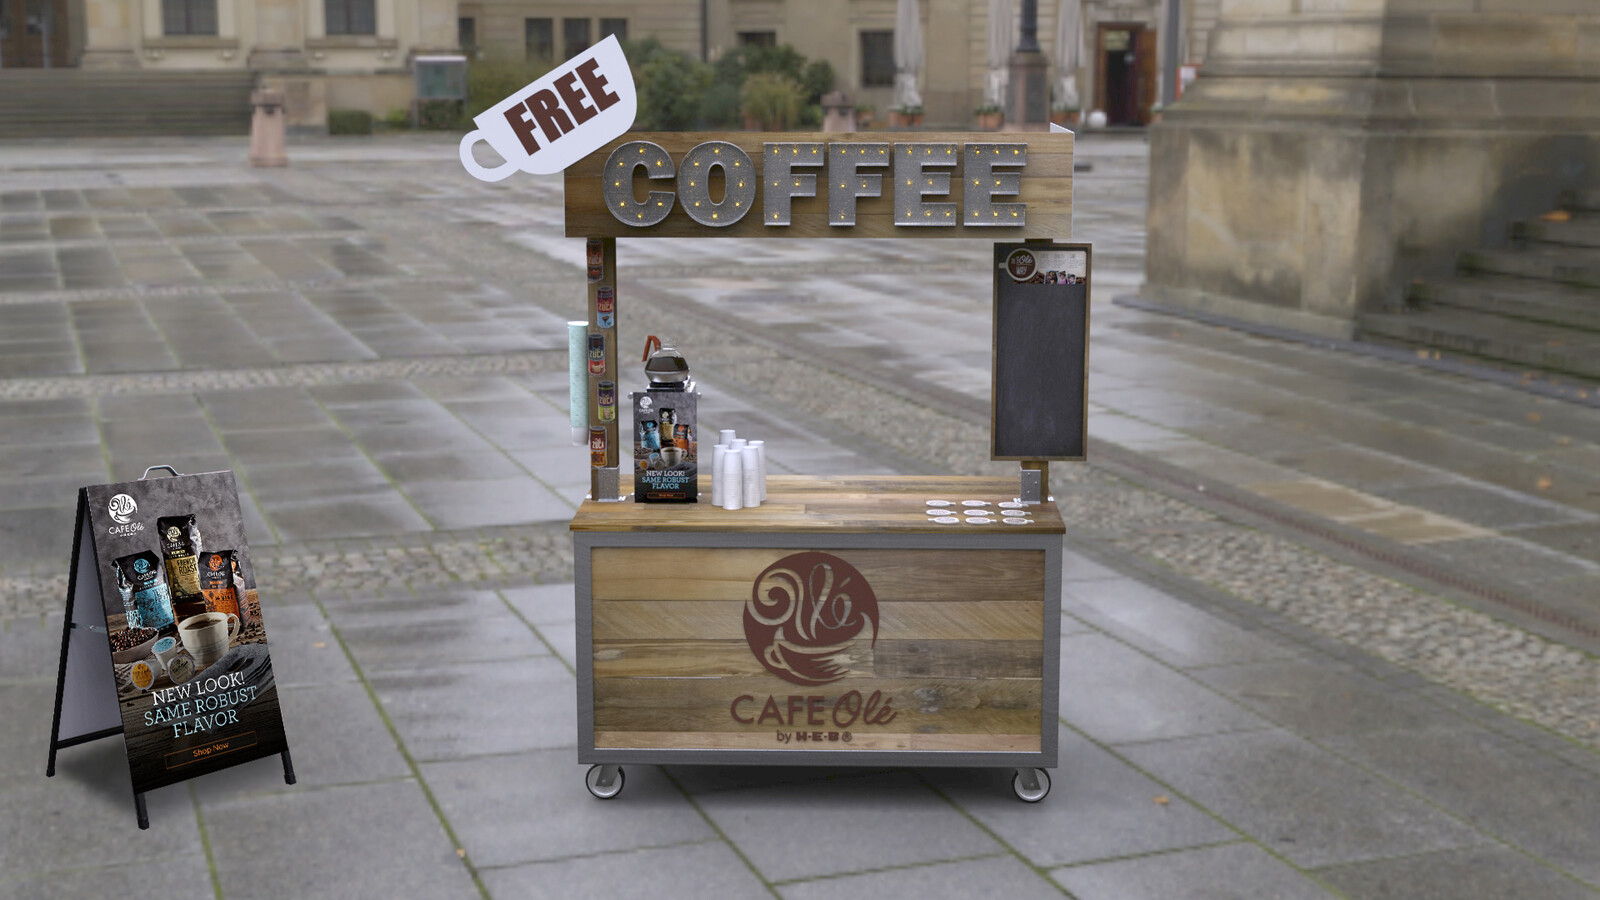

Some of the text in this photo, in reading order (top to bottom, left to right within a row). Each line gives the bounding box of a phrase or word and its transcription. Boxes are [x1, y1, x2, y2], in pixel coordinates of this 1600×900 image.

[503, 57, 620, 157] FREE
[603, 140, 1028, 227] COFFEE
[598, 303, 613, 311] ZUCA
[589, 350, 604, 358] ZUCA
[592, 441, 604, 449] ZUCA
[108, 524, 130, 535] CAFE
[151, 672, 246, 706] NEW LOOK!
[144, 686, 257, 727] SAME ROBUST
[730, 690, 898, 728] CAFE Olé
[172, 710, 240, 738] FLAVOR
[776, 730, 792, 744] by
[192, 742, 230, 758] Shop Now
